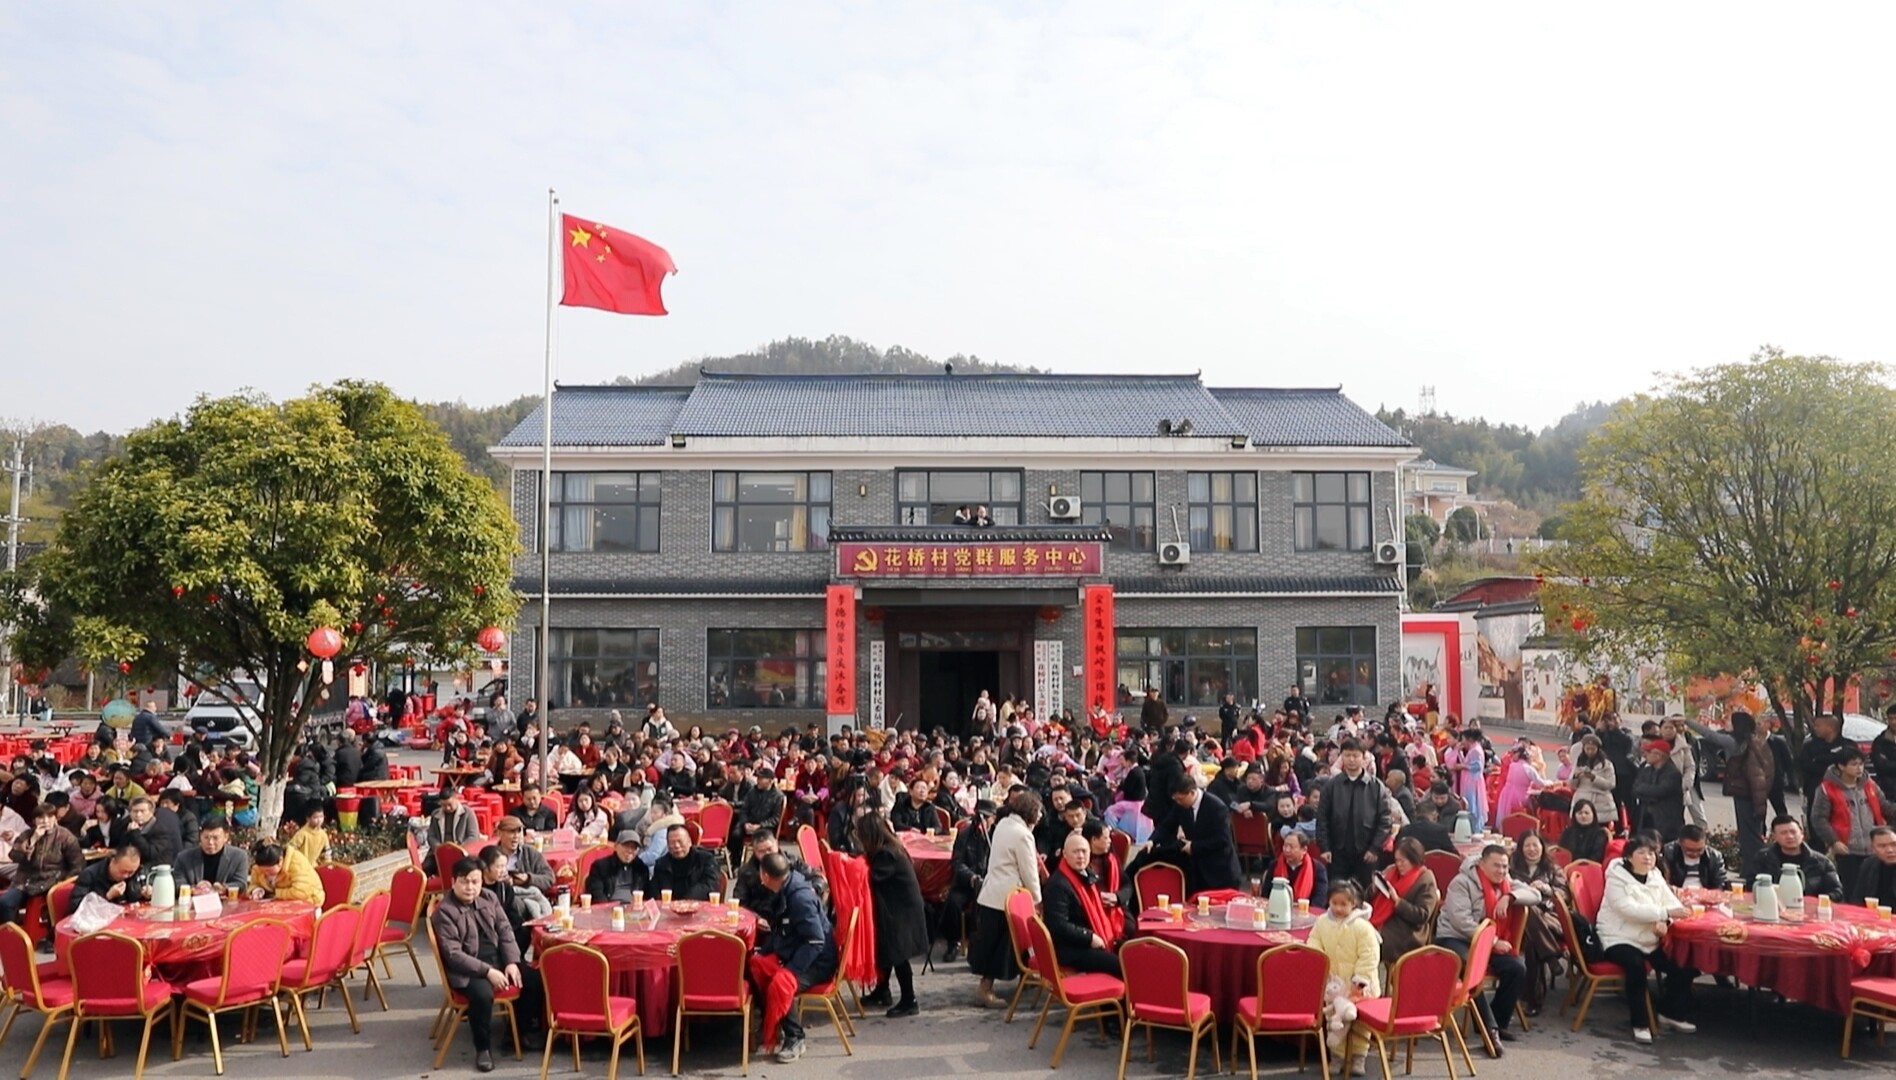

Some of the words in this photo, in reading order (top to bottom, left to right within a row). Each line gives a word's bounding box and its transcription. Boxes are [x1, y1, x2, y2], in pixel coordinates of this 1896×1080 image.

[883, 547, 1086, 567] 花桥村党群服务中心
